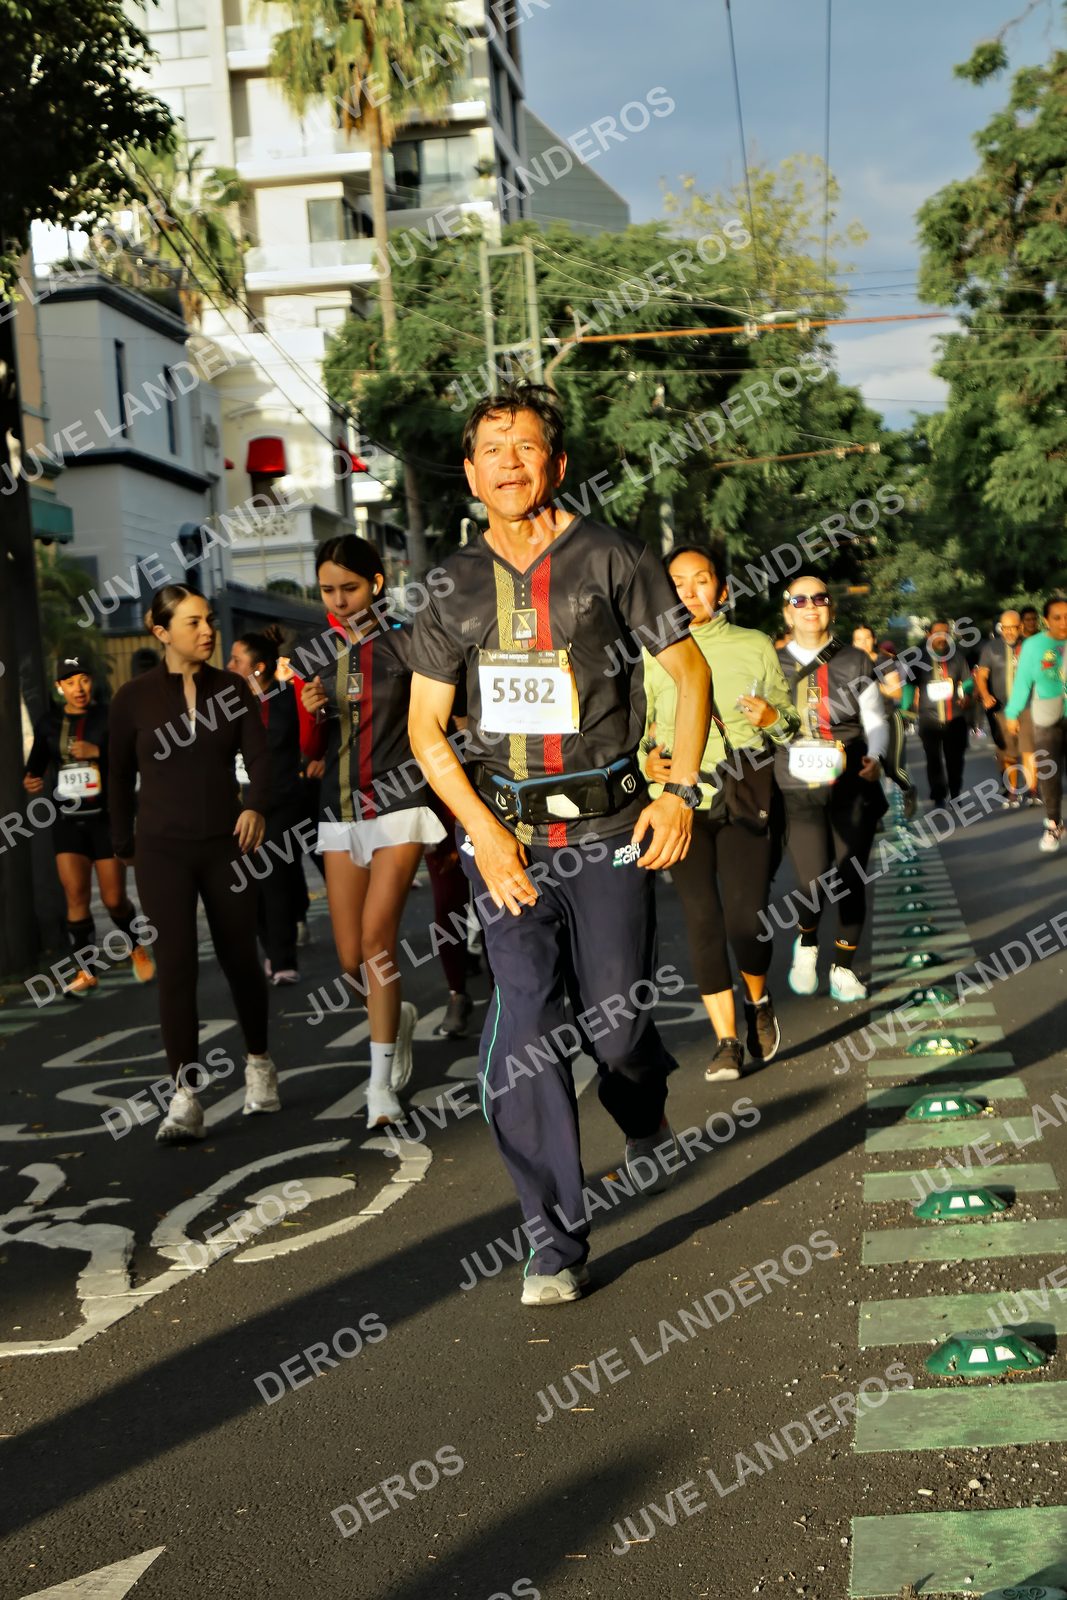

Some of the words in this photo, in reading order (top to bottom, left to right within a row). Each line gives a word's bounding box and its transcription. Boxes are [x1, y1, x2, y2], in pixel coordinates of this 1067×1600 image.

[493, 677, 555, 703] 5582
[798, 754, 834, 768] 5958
[64, 772, 90, 785] 1913
